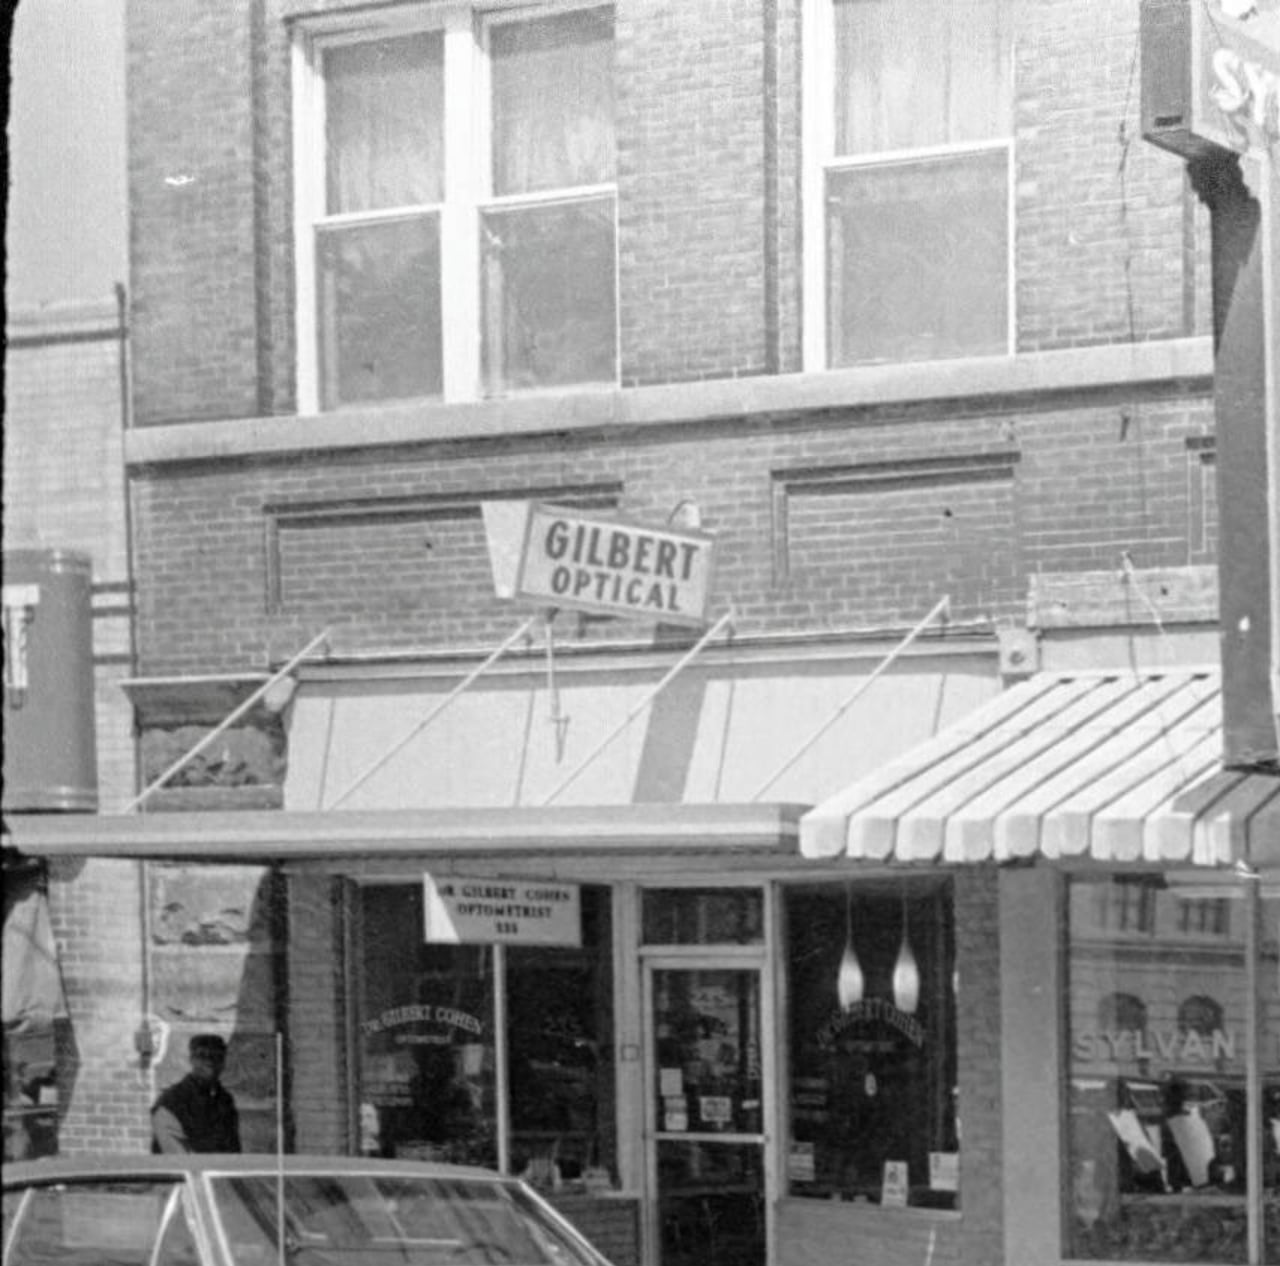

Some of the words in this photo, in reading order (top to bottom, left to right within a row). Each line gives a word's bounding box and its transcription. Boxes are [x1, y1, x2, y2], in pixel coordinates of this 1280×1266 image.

[543, 519, 700, 582] GILBERT
[550, 568, 682, 612] OPTICAL
[462, 885, 517, 900] GILBERT
[525, 888, 571, 902] COHEN
[457, 902, 553, 919] OPTOMETRIST
[435, 1005, 482, 1036] COHEN
[1074, 1031, 1235, 1062] SYLVAN
